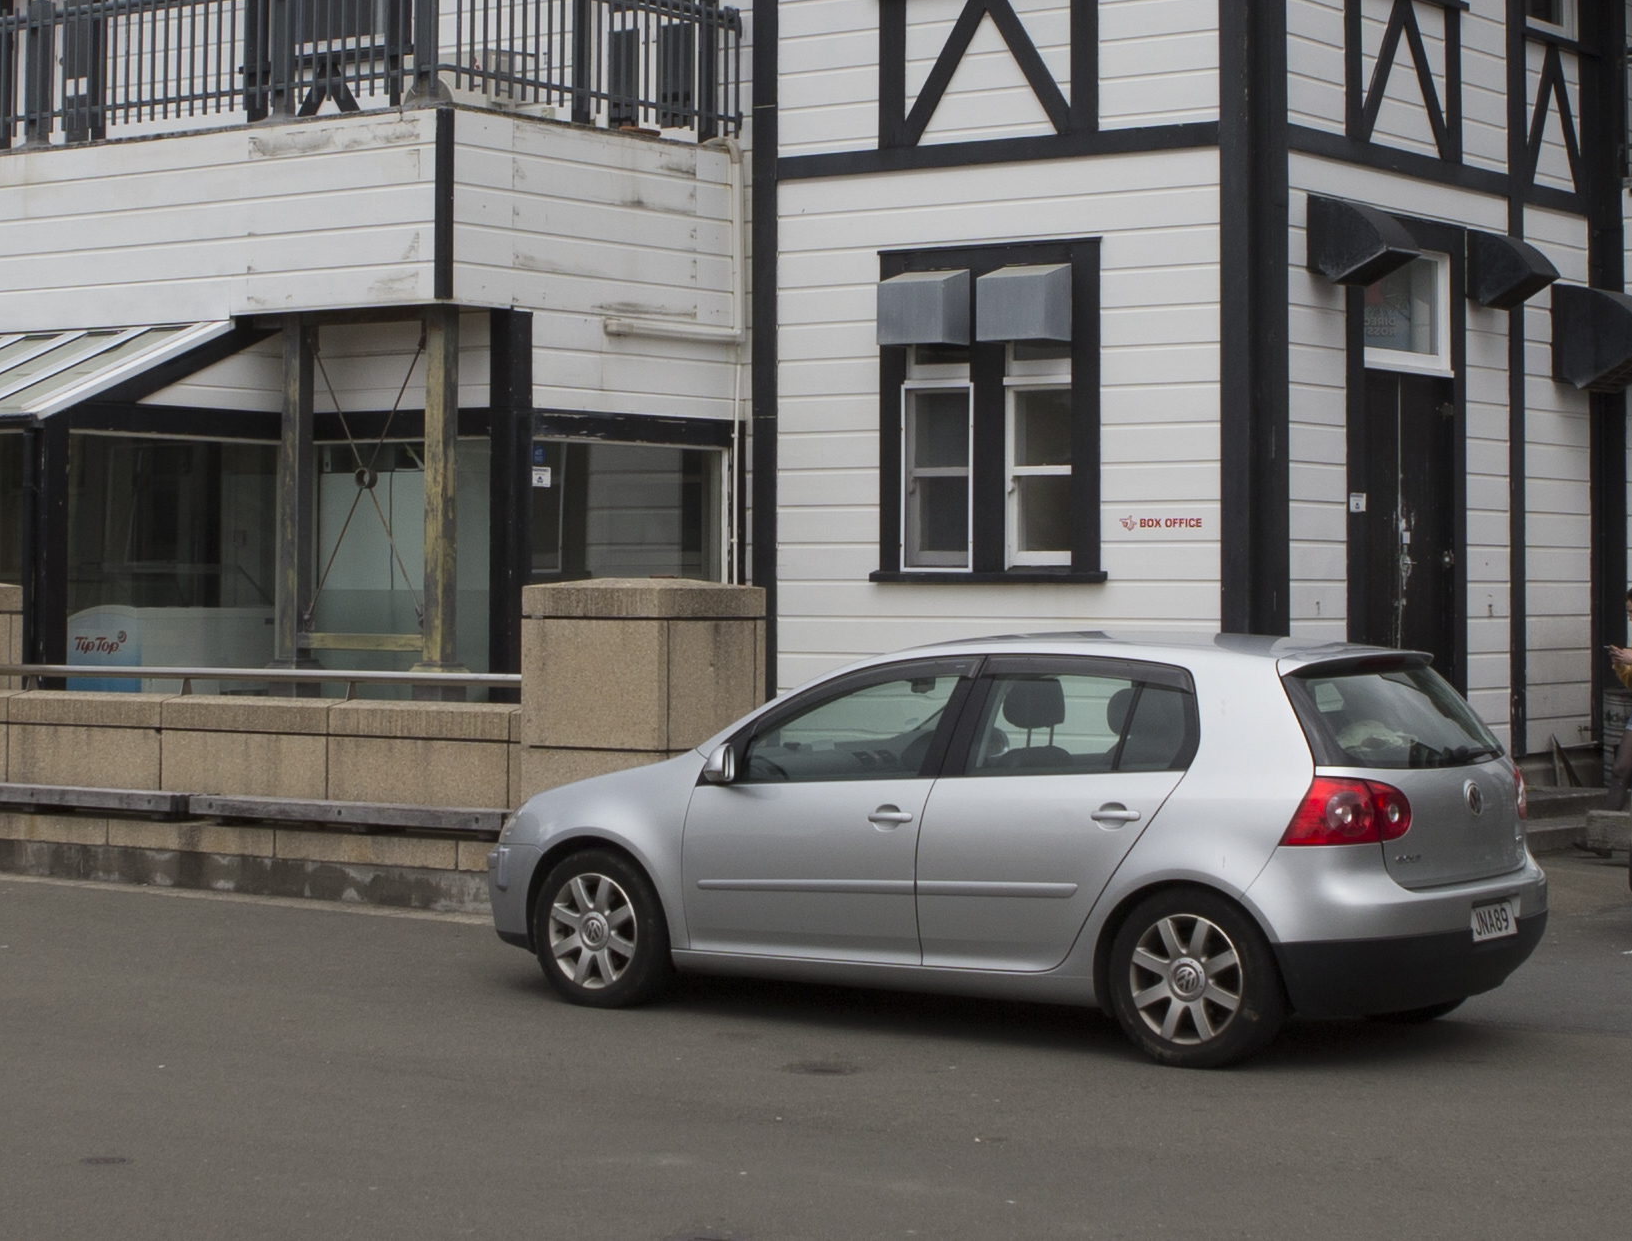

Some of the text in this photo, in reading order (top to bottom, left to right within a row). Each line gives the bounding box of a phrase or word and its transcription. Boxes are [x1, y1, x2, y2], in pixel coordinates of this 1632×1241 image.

[1140, 518, 1202, 528] BOX OFFICE
[75, 636, 119, 655] Tip Top
[1475, 907, 1510, 936] JNA89
